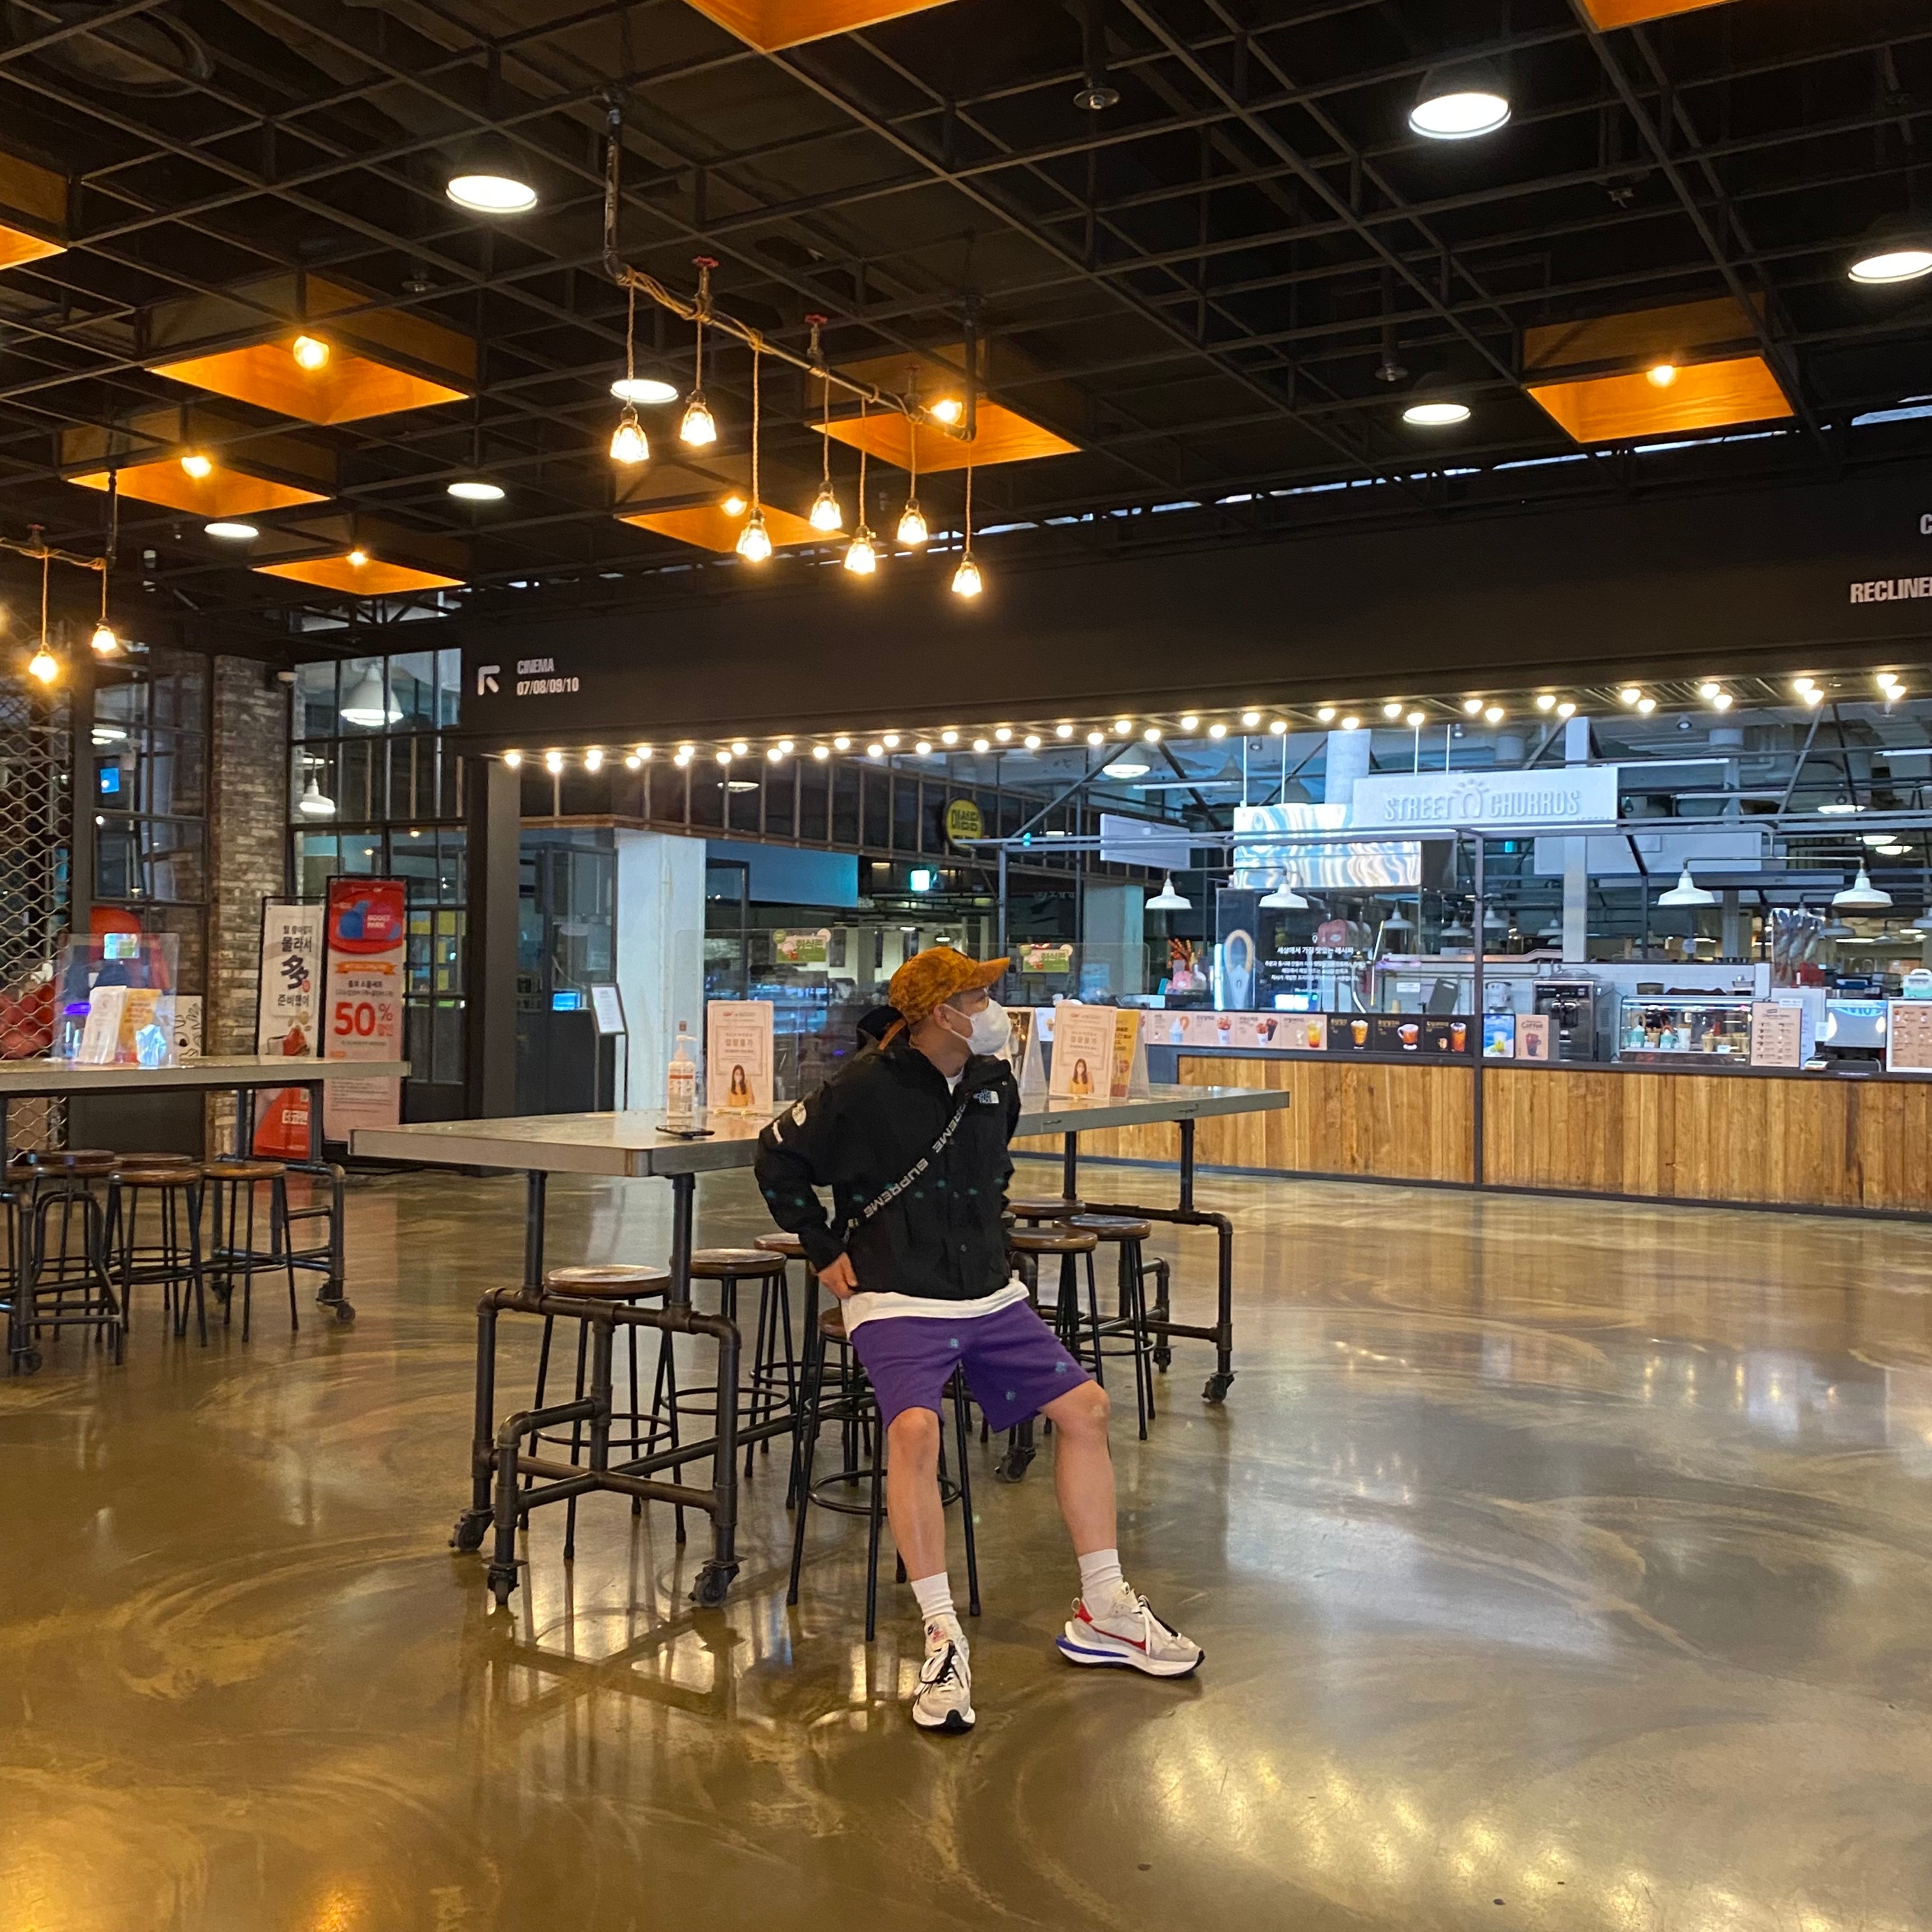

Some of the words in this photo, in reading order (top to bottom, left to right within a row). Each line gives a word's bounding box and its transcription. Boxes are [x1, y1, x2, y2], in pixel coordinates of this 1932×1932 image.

[1850, 576, 1932, 603] RECLINE
[517, 657, 555, 675] CINEMA
[517, 677, 579, 696] 07/08/09/10
[1384, 795, 1456, 822] STREET
[1489, 790, 1581, 818] CHURROS
[281, 936, 312, 953] 몰라서
[1277, 946, 1301, 954] 세상에서
[281, 954, 309, 990] 多
[277, 993, 310, 1007] 준비했어
[334, 1001, 394, 1036] 50%
[932, 1102, 967, 1153] PREME
[863, 1158, 929, 1218] SUPREME
